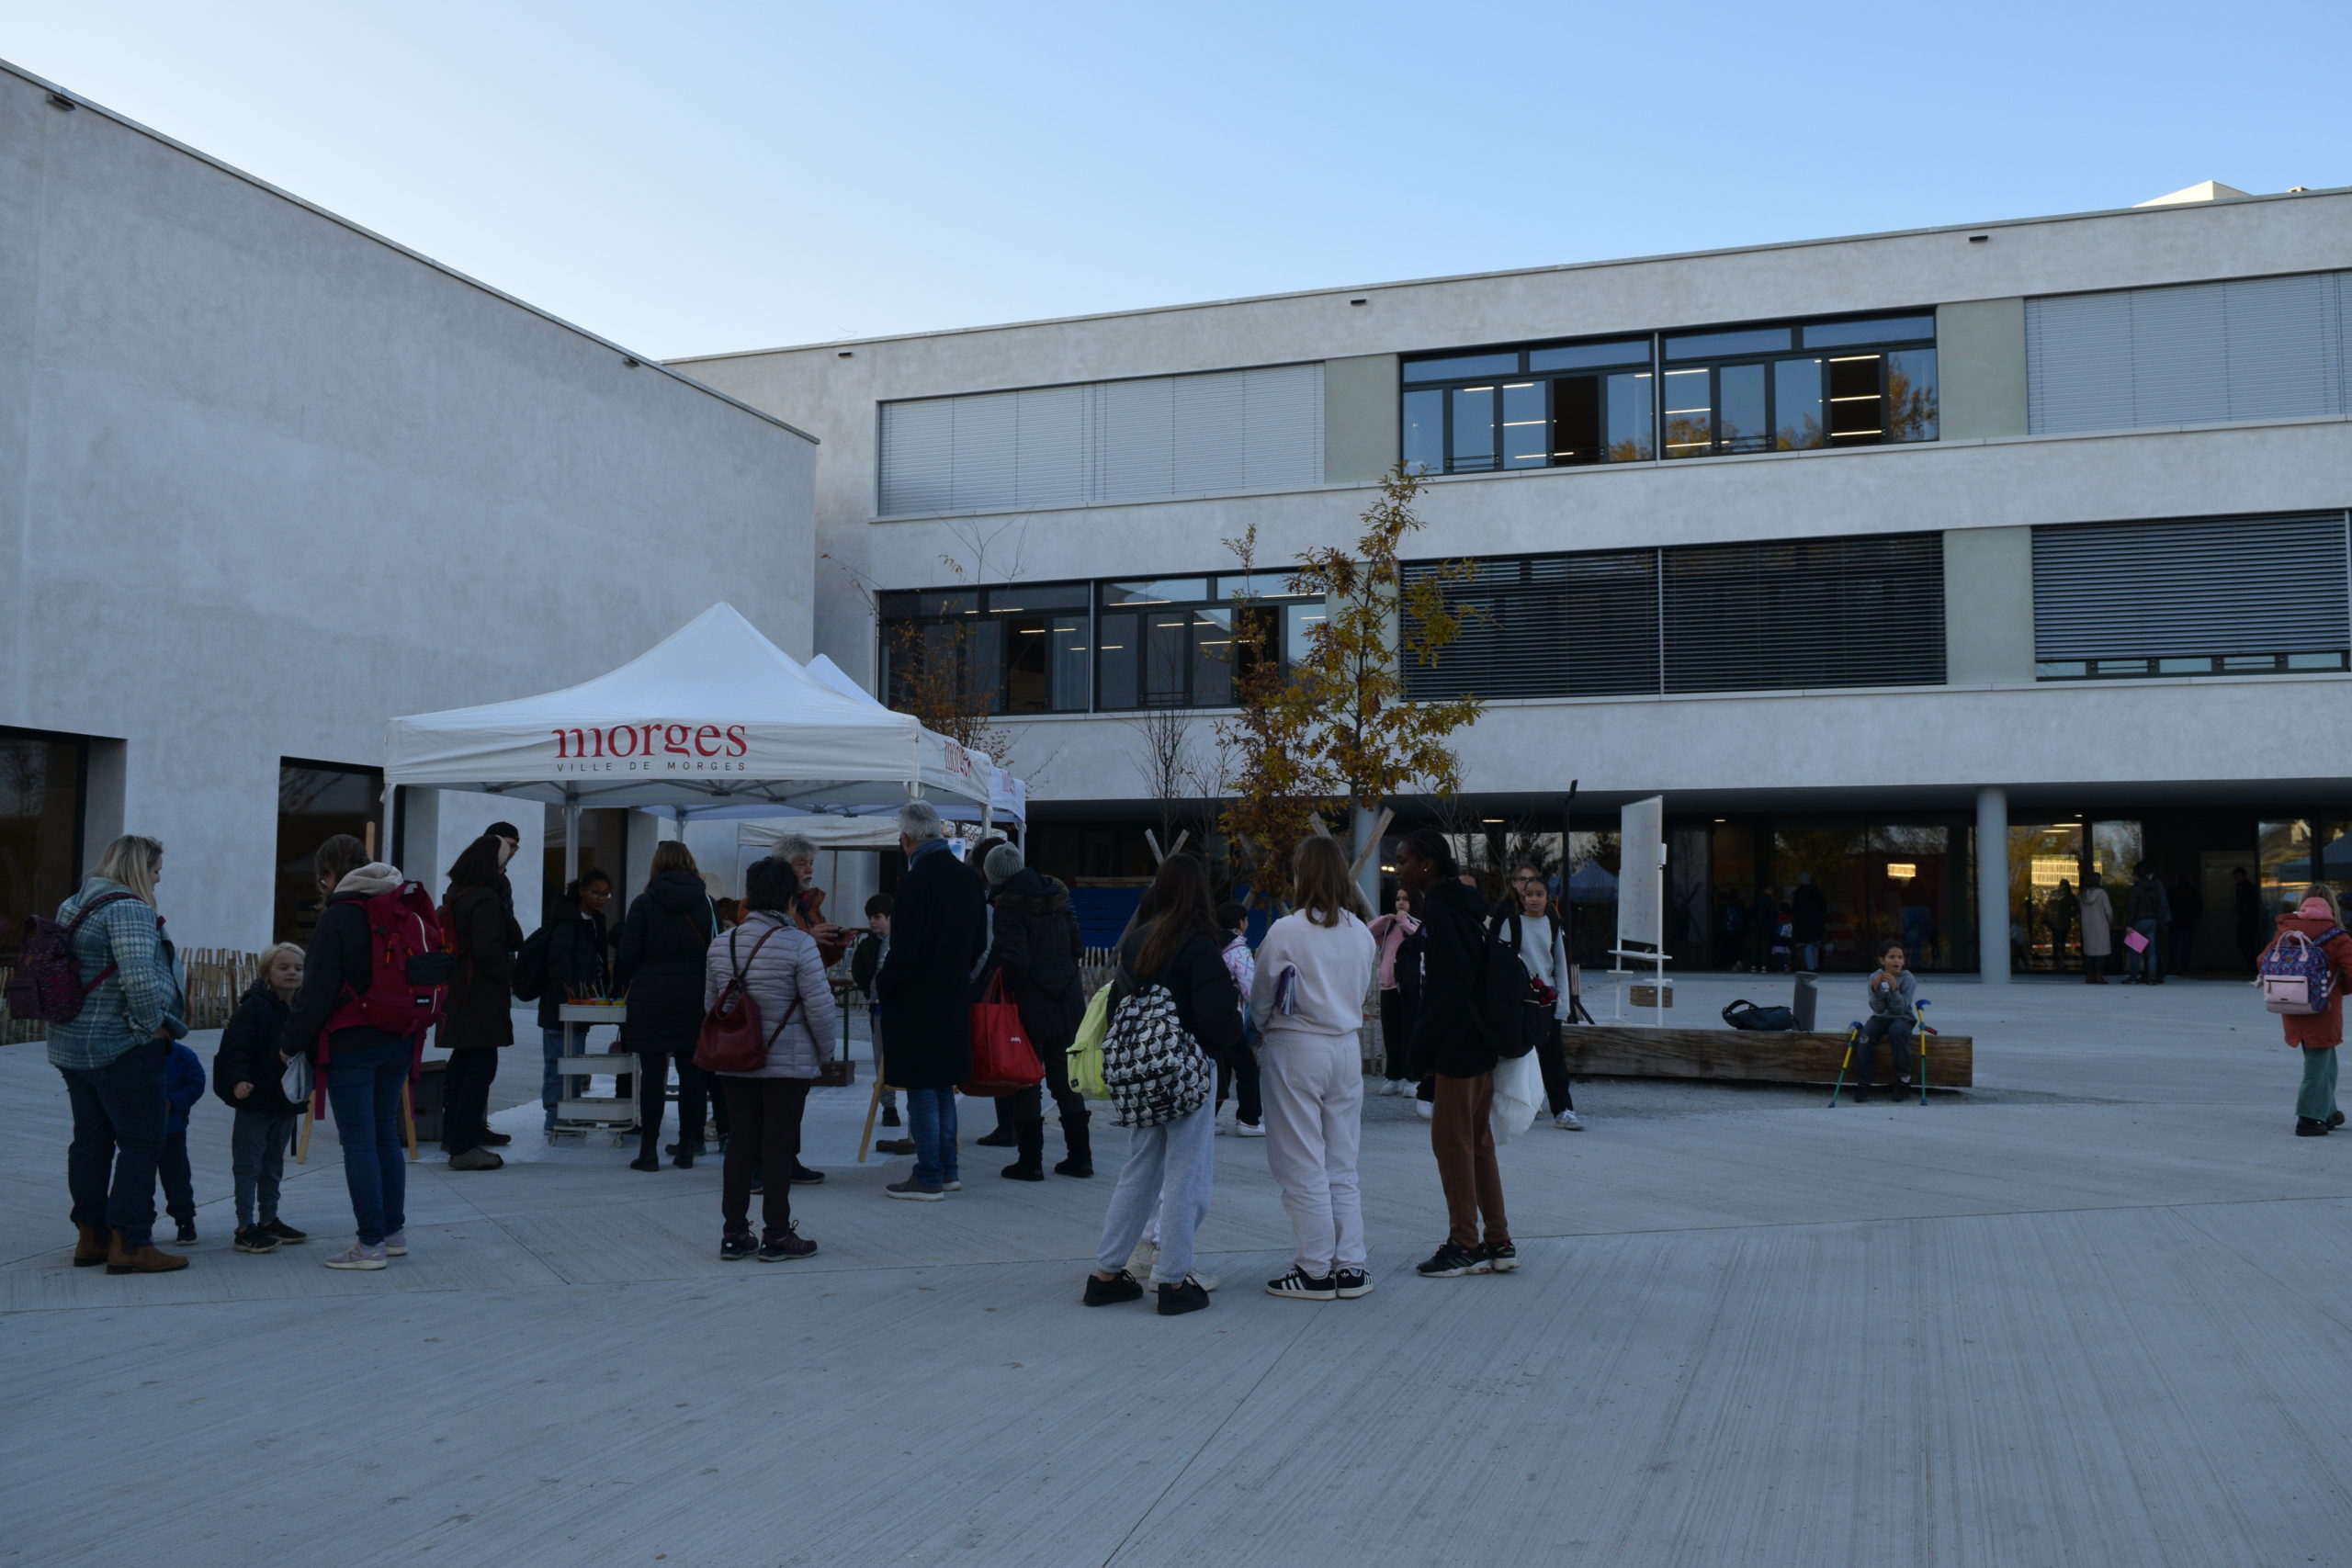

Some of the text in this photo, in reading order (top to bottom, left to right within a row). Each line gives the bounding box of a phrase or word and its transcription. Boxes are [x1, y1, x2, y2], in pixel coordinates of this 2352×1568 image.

[551, 723, 748, 759] morges
[557, 761, 745, 773] VILLE DE MORGES
